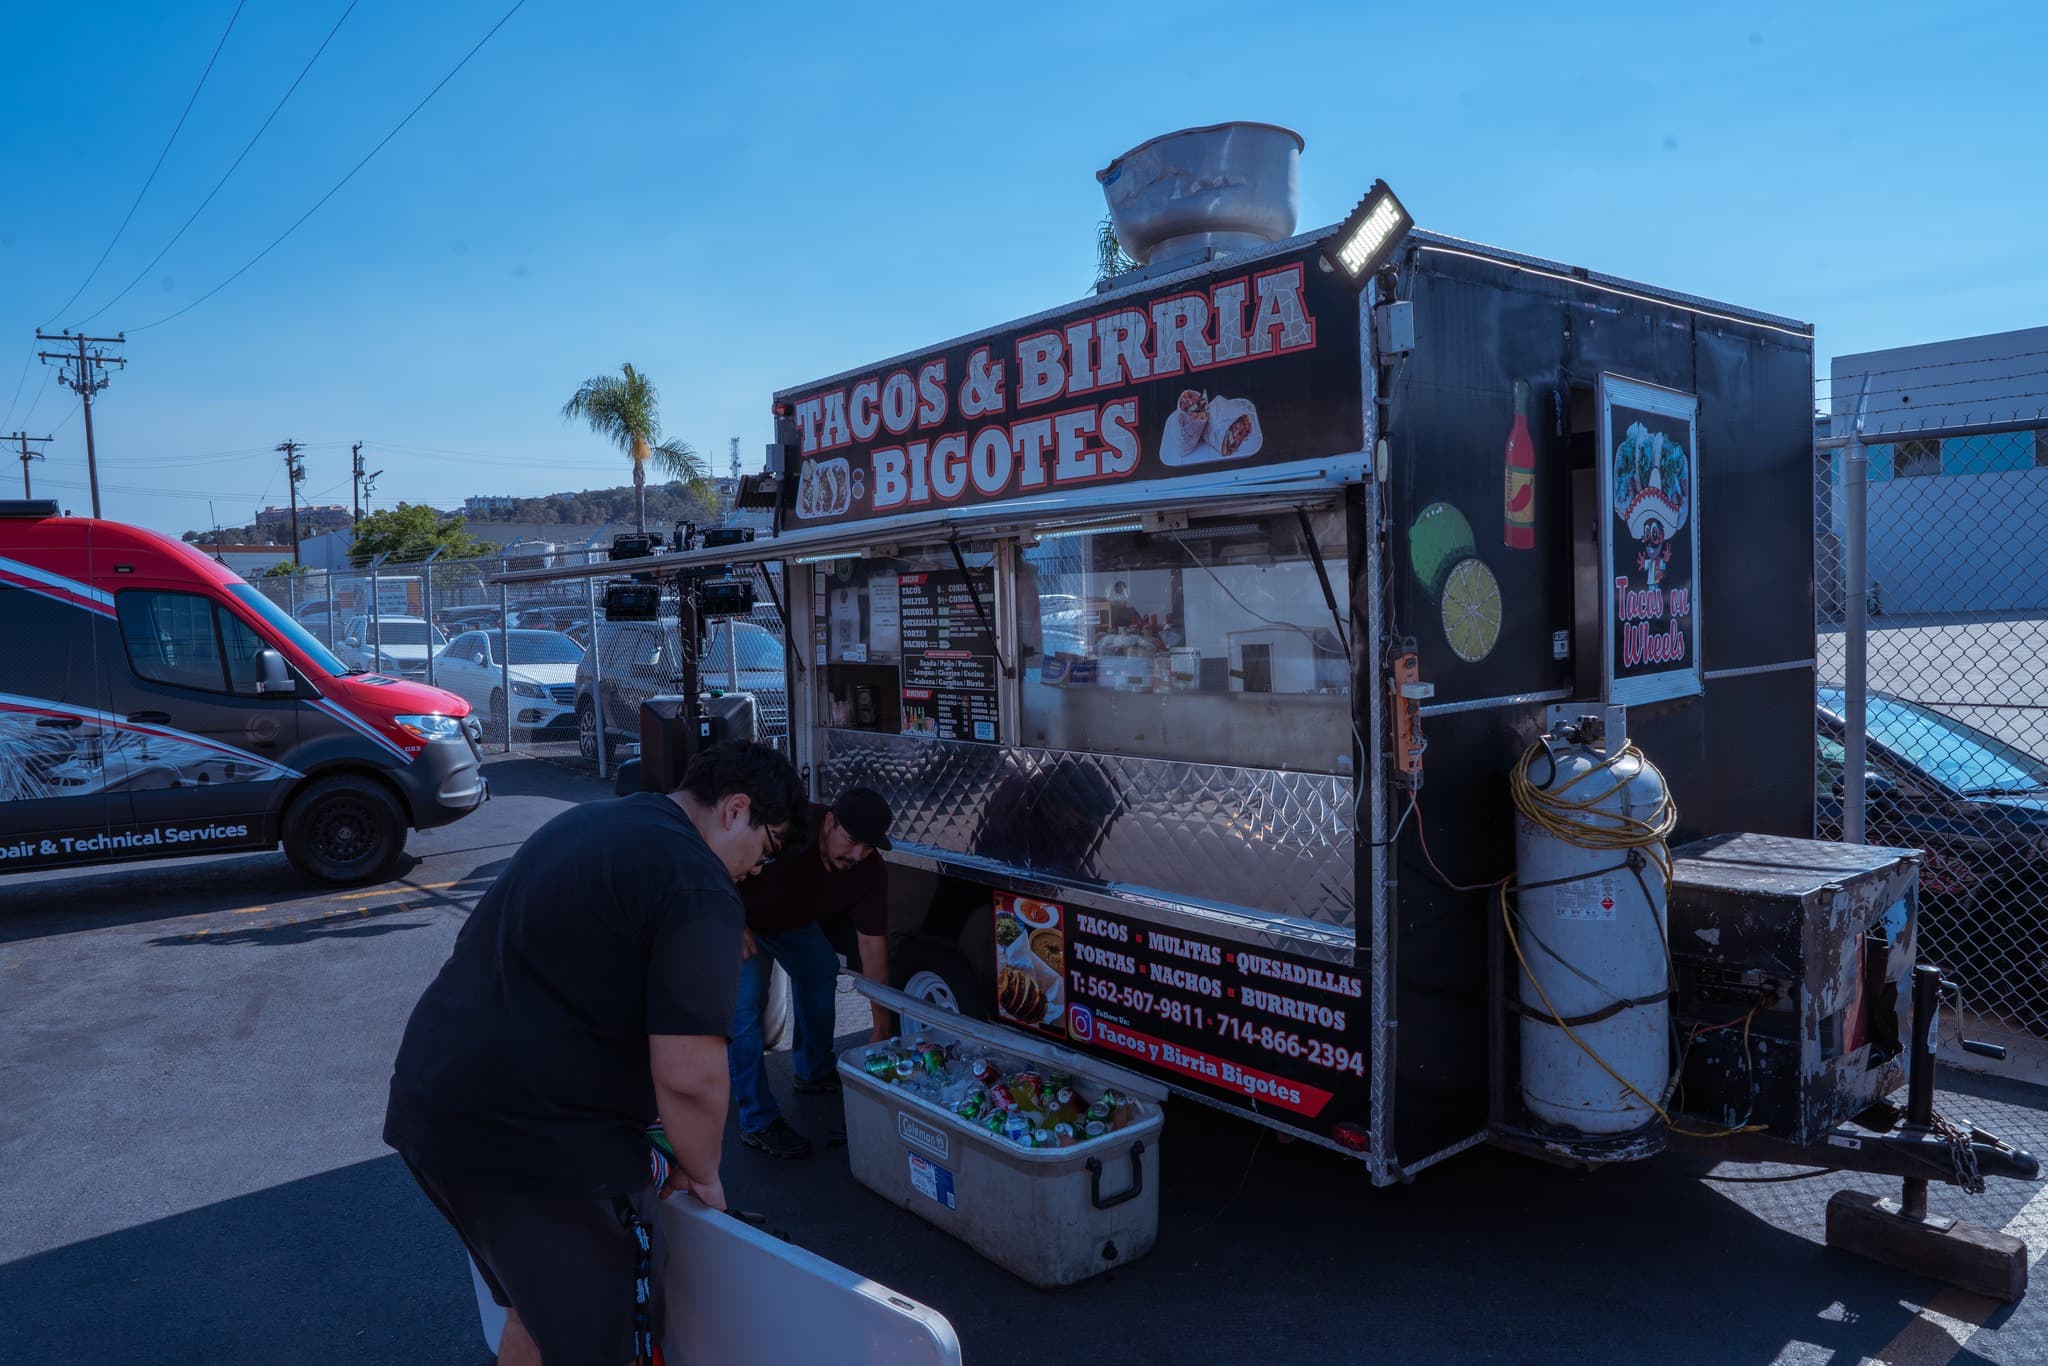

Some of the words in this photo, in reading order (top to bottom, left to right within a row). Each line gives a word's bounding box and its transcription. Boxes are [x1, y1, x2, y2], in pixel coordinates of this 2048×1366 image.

[794, 356, 948, 456] TACOS
[960, 345, 1006, 421] &
[1015, 260, 1317, 409] BIRRIA
[870, 396, 1140, 511] BIGOTES
[901, 586, 921, 595] TACOS
[902, 597, 928, 606] MULITAS
[1615, 576, 1663, 621] Tacos
[1670, 588, 1690, 615] on
[902, 607, 934, 616] BURRITOS
[902, 618, 938, 628] QUESADILLAS
[903, 629, 927, 638] TORTAS
[903, 640, 929, 648] NACHOS
[1624, 619, 1684, 668] Wheels
[39, 839, 58, 856] &
[60, 828, 163, 853] Technical
[164, 823, 248, 844] Services
[1077, 914, 1128, 942] TACOS
[1148, 931, 1222, 966] MULITAS
[1236, 952, 1362, 998] QUESADILLAS
[1073, 942, 1136, 975] TORTAS
[1149, 962, 1223, 999] NACHOS
[1240, 986, 1346, 1032] BURRITOS
[1096, 1022, 1146, 1053] Tacos
[1149, 1042, 1161, 1061] y
[1162, 1043, 1218, 1078] Birria
[1221, 1061, 1301, 1105] Bigotes
[1216, 1012, 1365, 1077] 714-866-2394
[902, 1116, 936, 1146] Coleman
